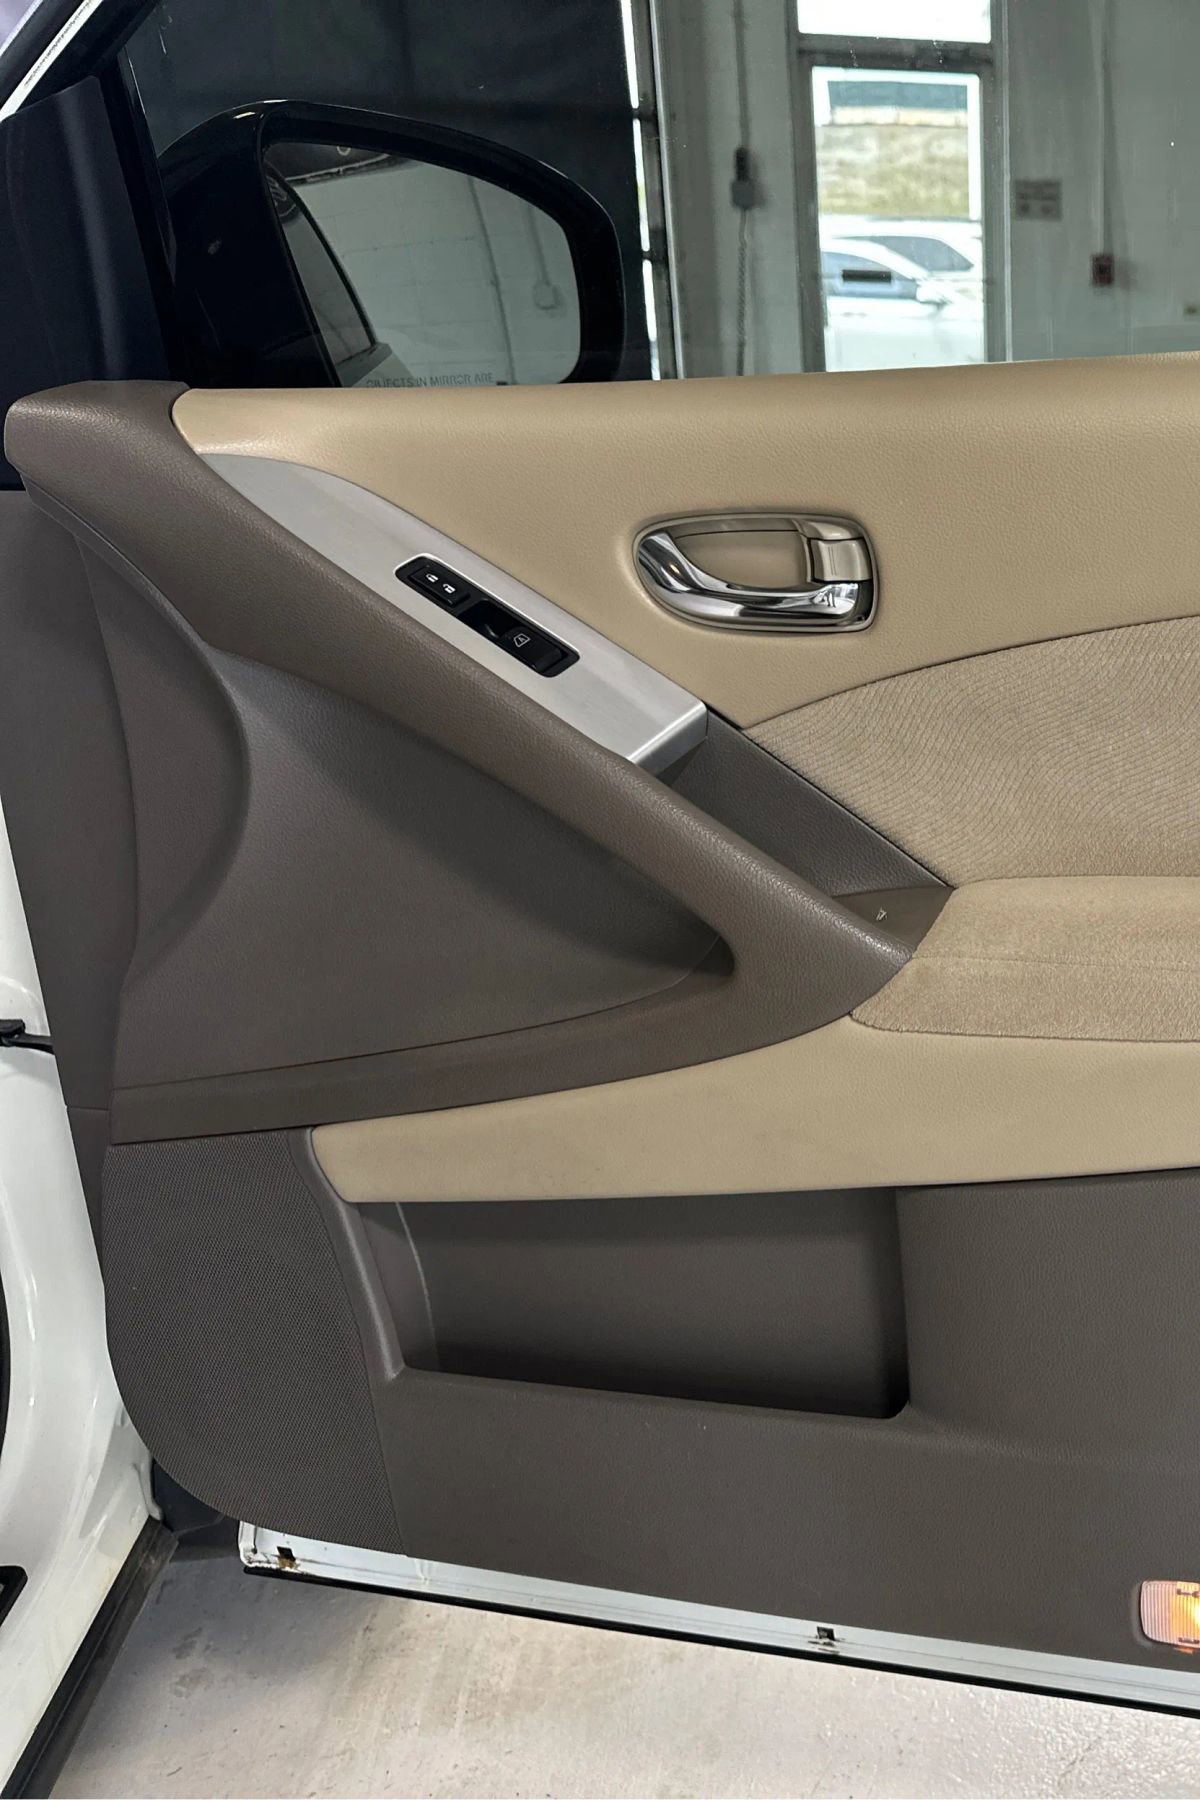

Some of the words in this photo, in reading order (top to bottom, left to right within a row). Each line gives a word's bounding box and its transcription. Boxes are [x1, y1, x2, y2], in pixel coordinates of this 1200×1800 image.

[366, 378, 414, 388] OBJECTS
[416, 376, 427, 387] IN
[429, 374, 471, 387] MIRROR
[474, 372, 494, 385] ARE
